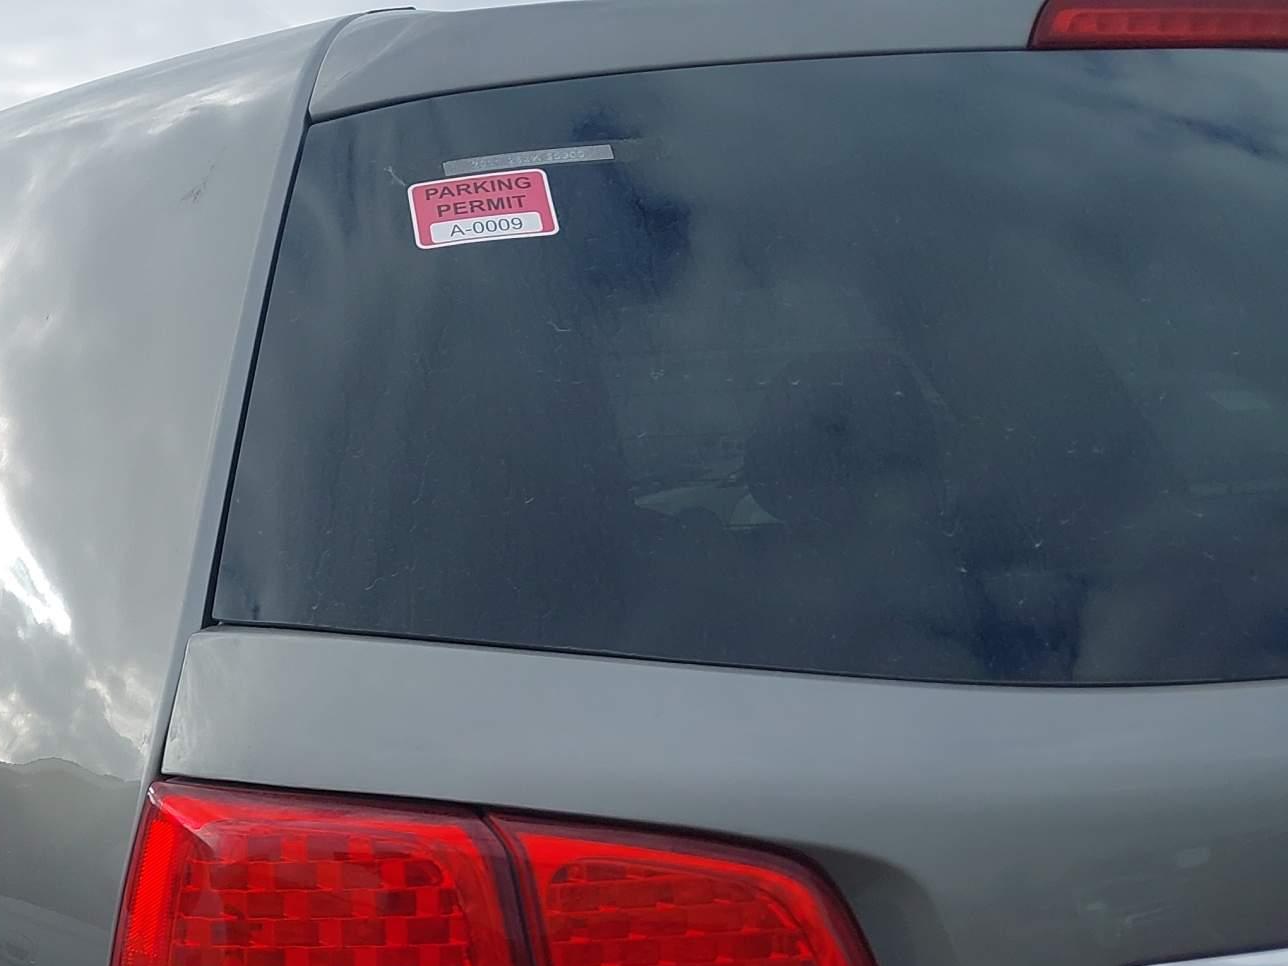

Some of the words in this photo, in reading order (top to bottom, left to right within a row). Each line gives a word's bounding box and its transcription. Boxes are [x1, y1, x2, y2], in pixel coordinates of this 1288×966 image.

[425, 176, 532, 201] PARKING
[437, 194, 527, 218] PERMIT
[450, 217, 523, 238] A-0009
